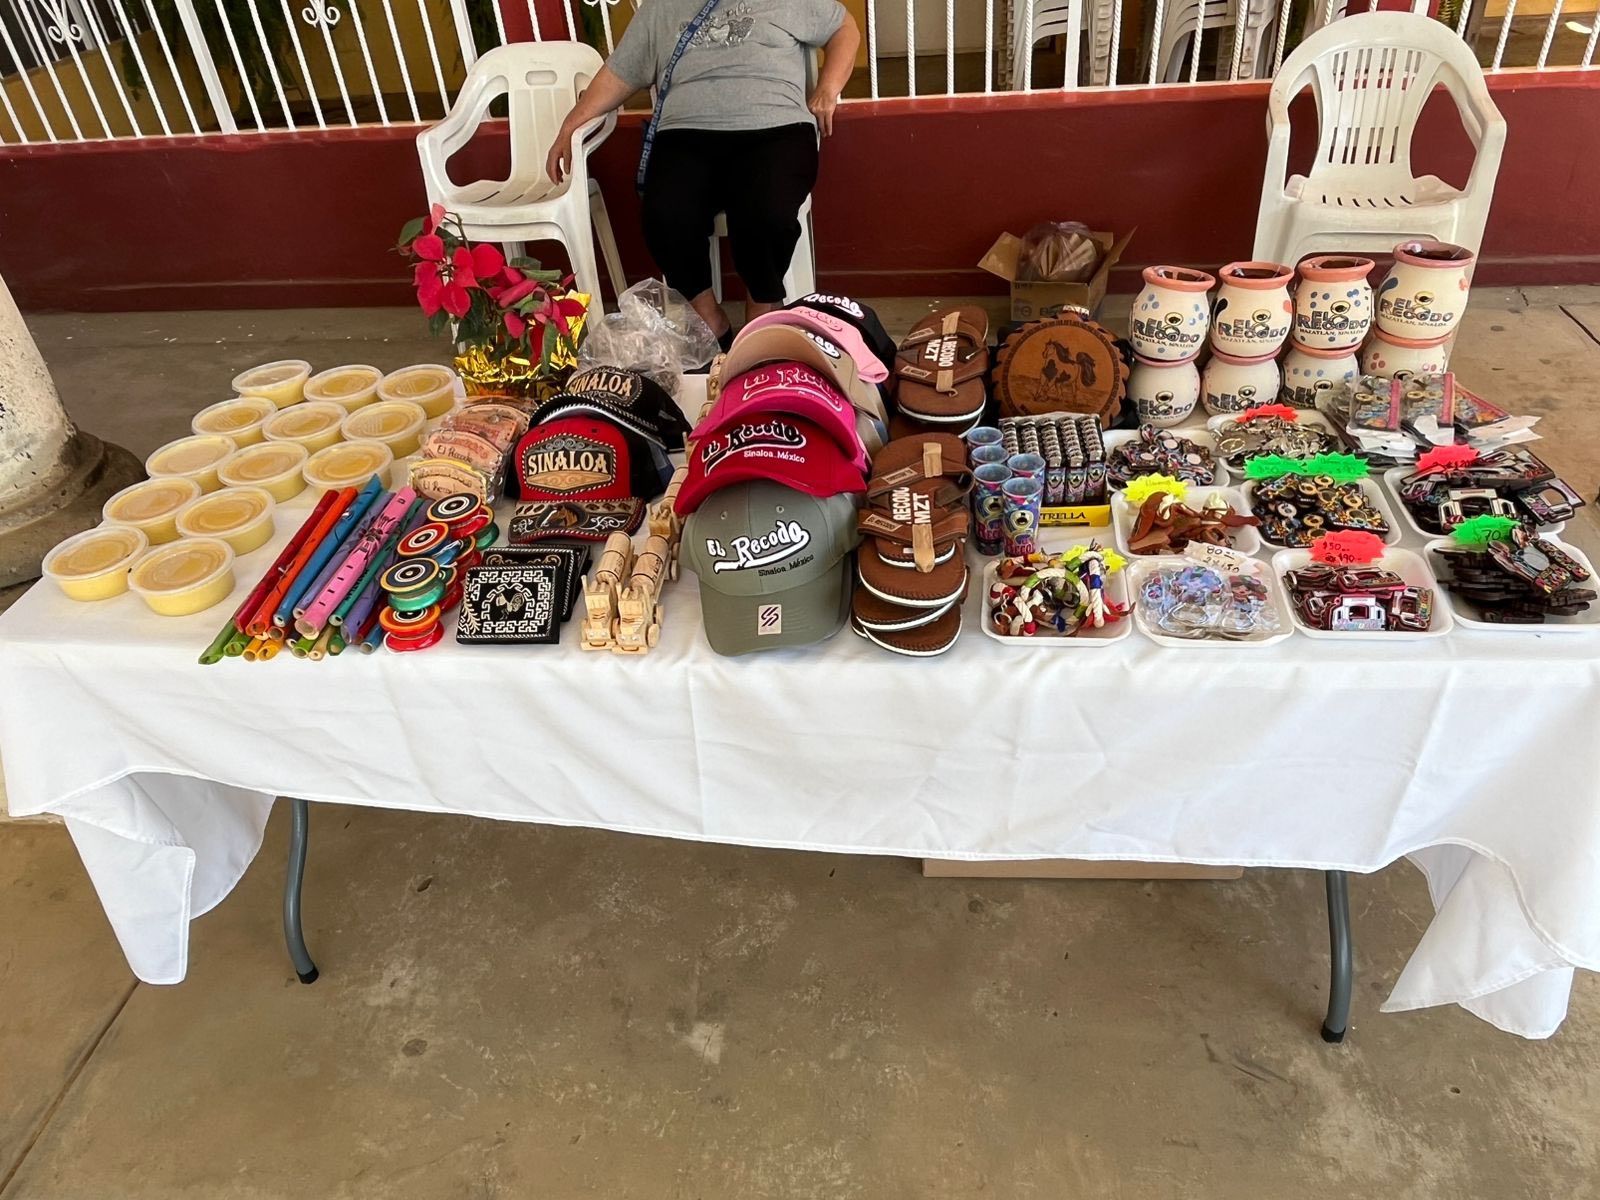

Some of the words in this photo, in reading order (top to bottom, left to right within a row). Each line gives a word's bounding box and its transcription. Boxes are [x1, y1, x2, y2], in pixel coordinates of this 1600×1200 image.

[924, 338, 942, 362] MZT
[938, 340, 958, 367] RECODO
[569, 372, 633, 397] SINALOA
[528, 450, 609, 476] SINALOA
[777, 450, 805, 464] México
[912, 492, 931, 524] MZT
[729, 519, 806, 564] Recodo
[758, 566, 787, 577] Sinaloa
